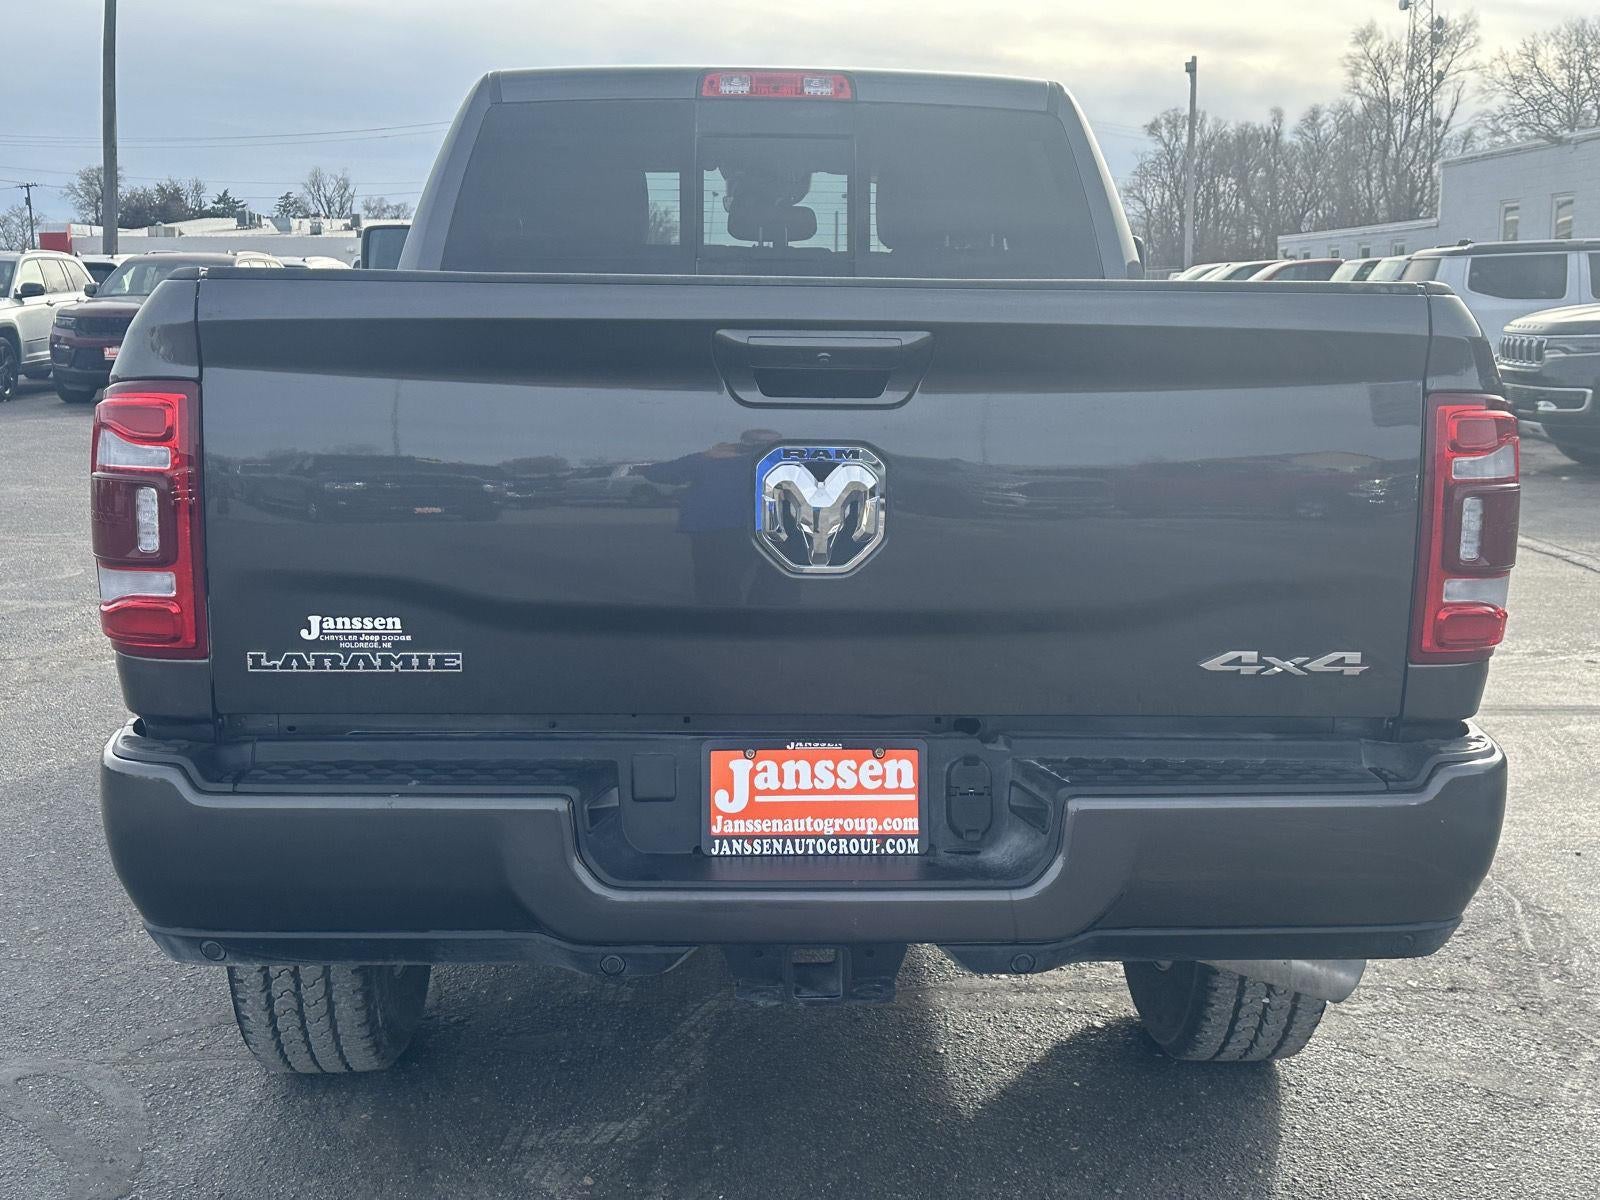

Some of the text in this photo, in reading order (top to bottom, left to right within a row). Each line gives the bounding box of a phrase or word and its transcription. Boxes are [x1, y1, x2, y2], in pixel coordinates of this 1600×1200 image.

[781, 448, 861, 460] RAM
[300, 615, 402, 640] Janssen
[247, 652, 462, 672] LARAMIE
[714, 758, 916, 814] Janssen
[712, 816, 919, 834] Janssenautogroup.com
[710, 838, 919, 855] JANSSENAUTOGROUP.COM
